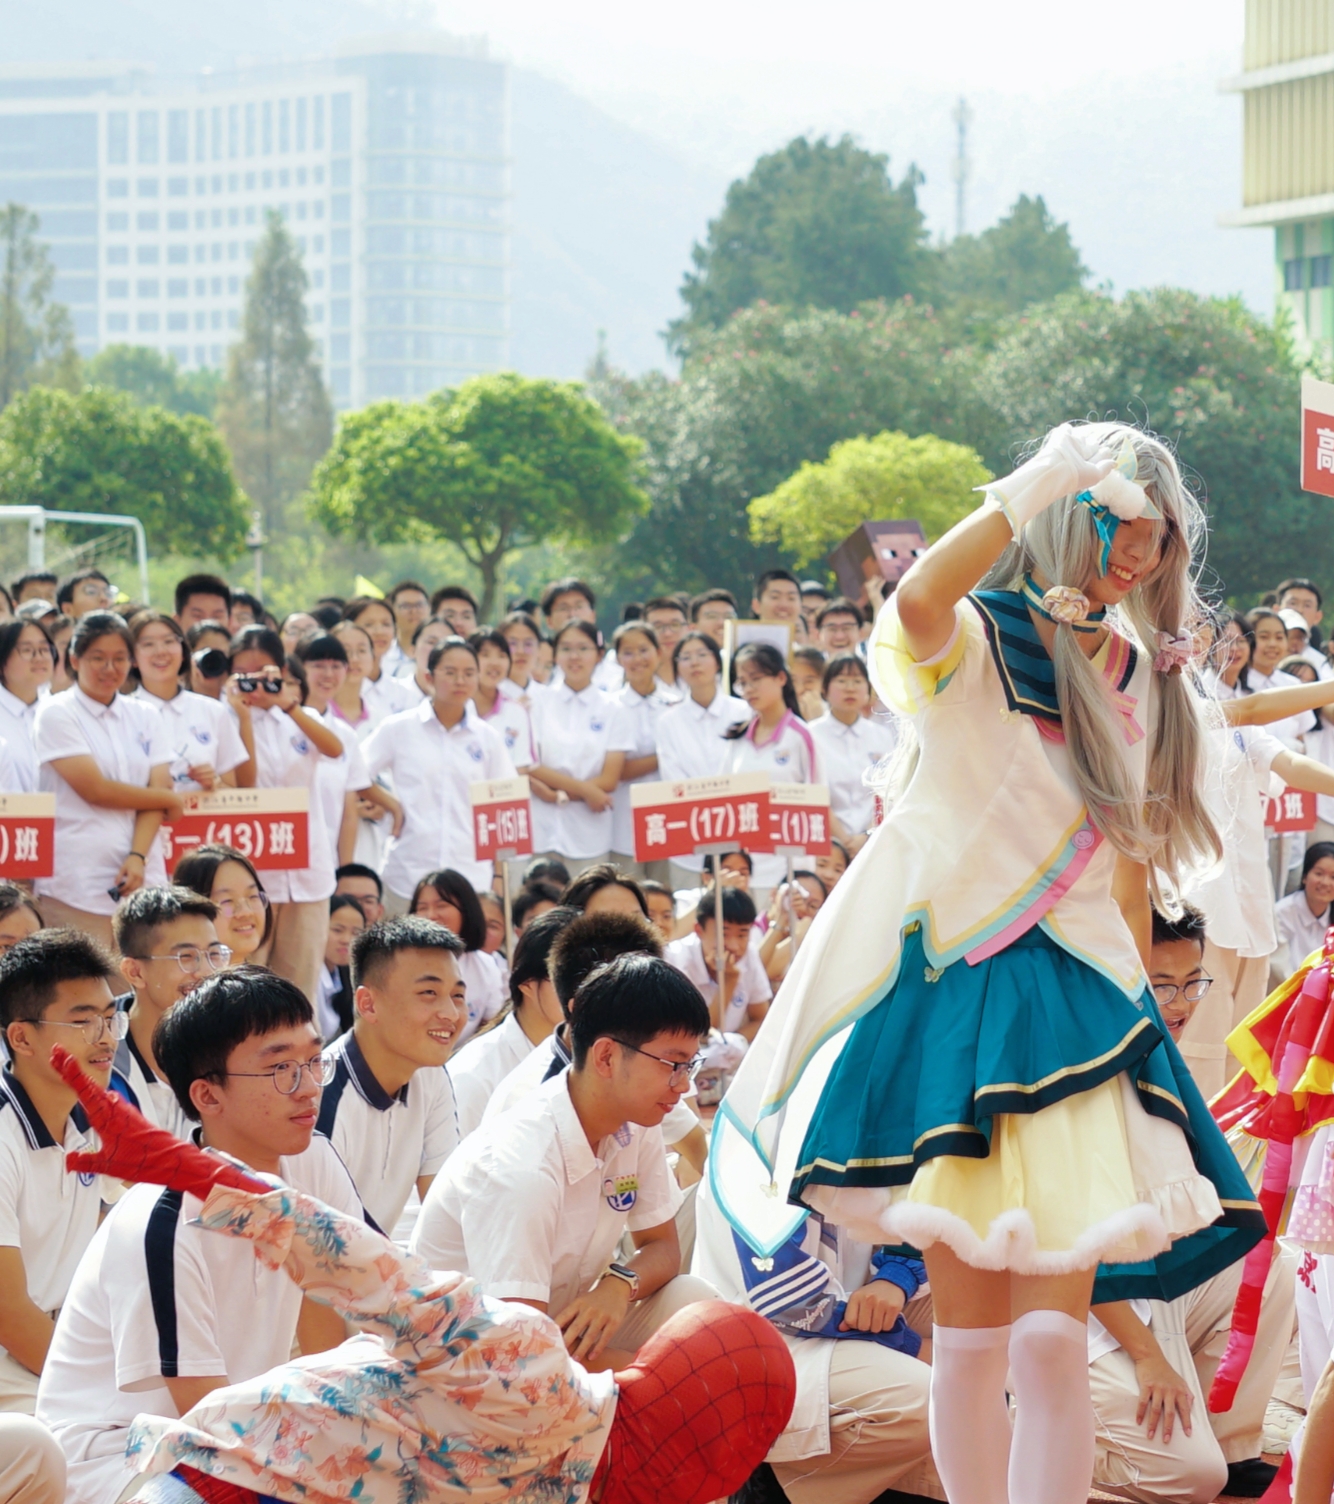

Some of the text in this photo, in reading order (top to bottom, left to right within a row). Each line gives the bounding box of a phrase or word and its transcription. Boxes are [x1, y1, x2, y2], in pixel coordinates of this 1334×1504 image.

[477, 808, 528, 846] 高一(15)班
[645, 802, 759, 846] 高一(17)班
